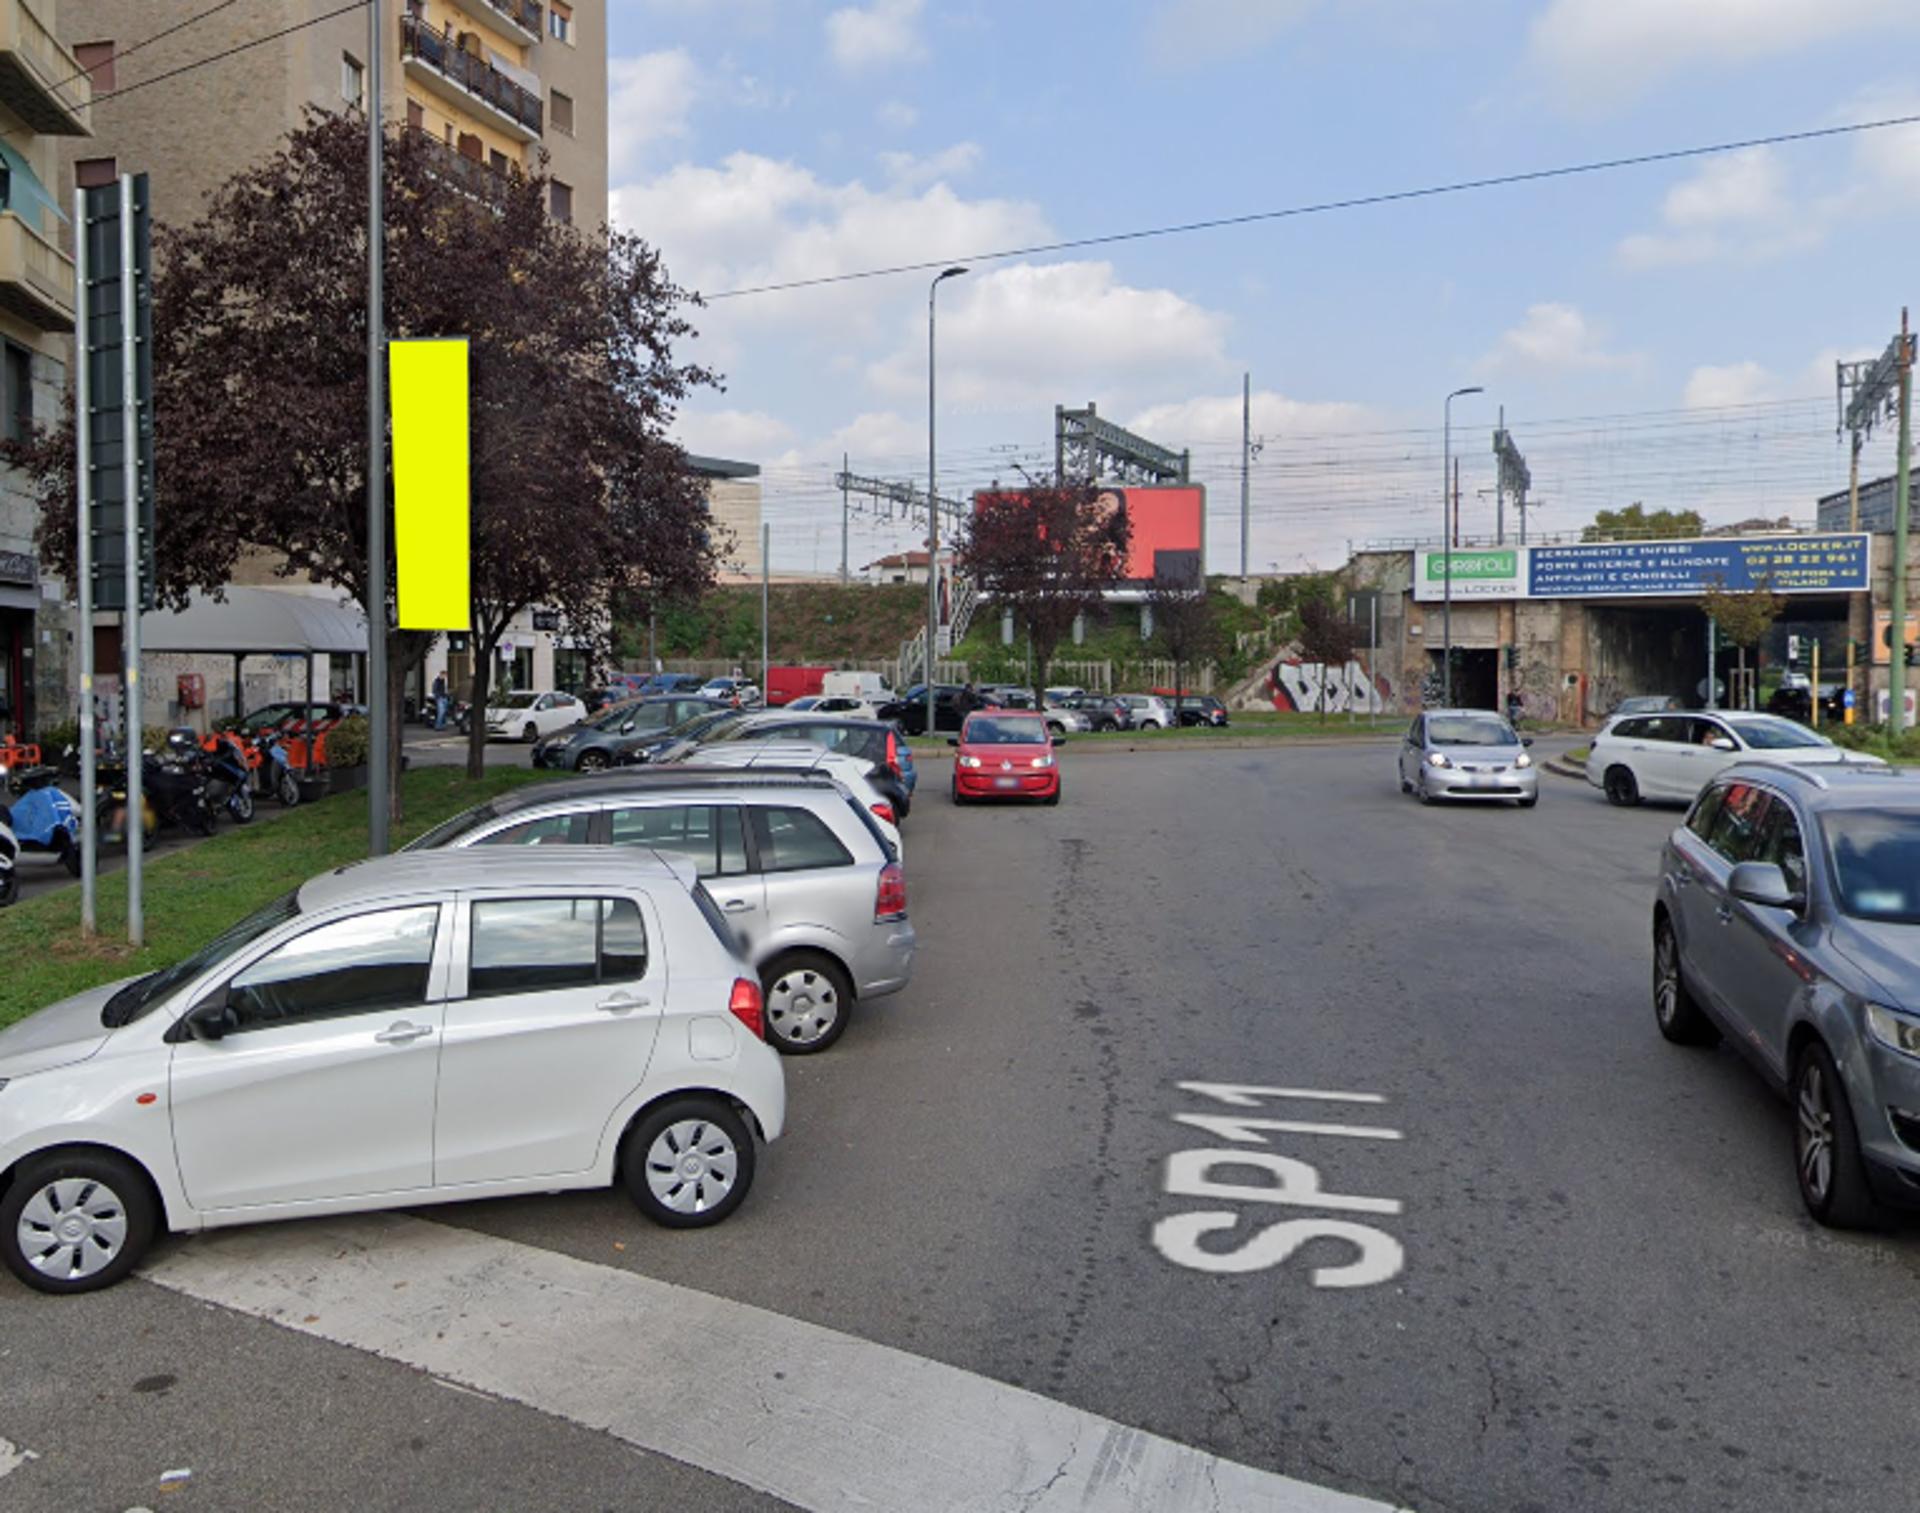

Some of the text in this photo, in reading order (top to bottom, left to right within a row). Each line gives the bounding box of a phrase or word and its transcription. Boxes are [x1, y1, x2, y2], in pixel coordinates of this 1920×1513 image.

[1536, 546, 1692, 558] SERRAMENTI E INFISSI
[1536, 562, 1578, 571] PORTE
[1583, 560, 1641, 569] INTERNE
[1661, 557, 1729, 566] BLINDATE
[1746, 555, 1767, 565] 02
[1774, 555, 1793, 564] 28
[1800, 554, 1820, 563] 22
[1536, 571, 1690, 582] ANTIFURTI E CANCELLI
[1778, 578, 1828, 586] MILANO
[1465, 585, 1516, 593] LOCKER
[1153, 1081, 1404, 1288] SP11
